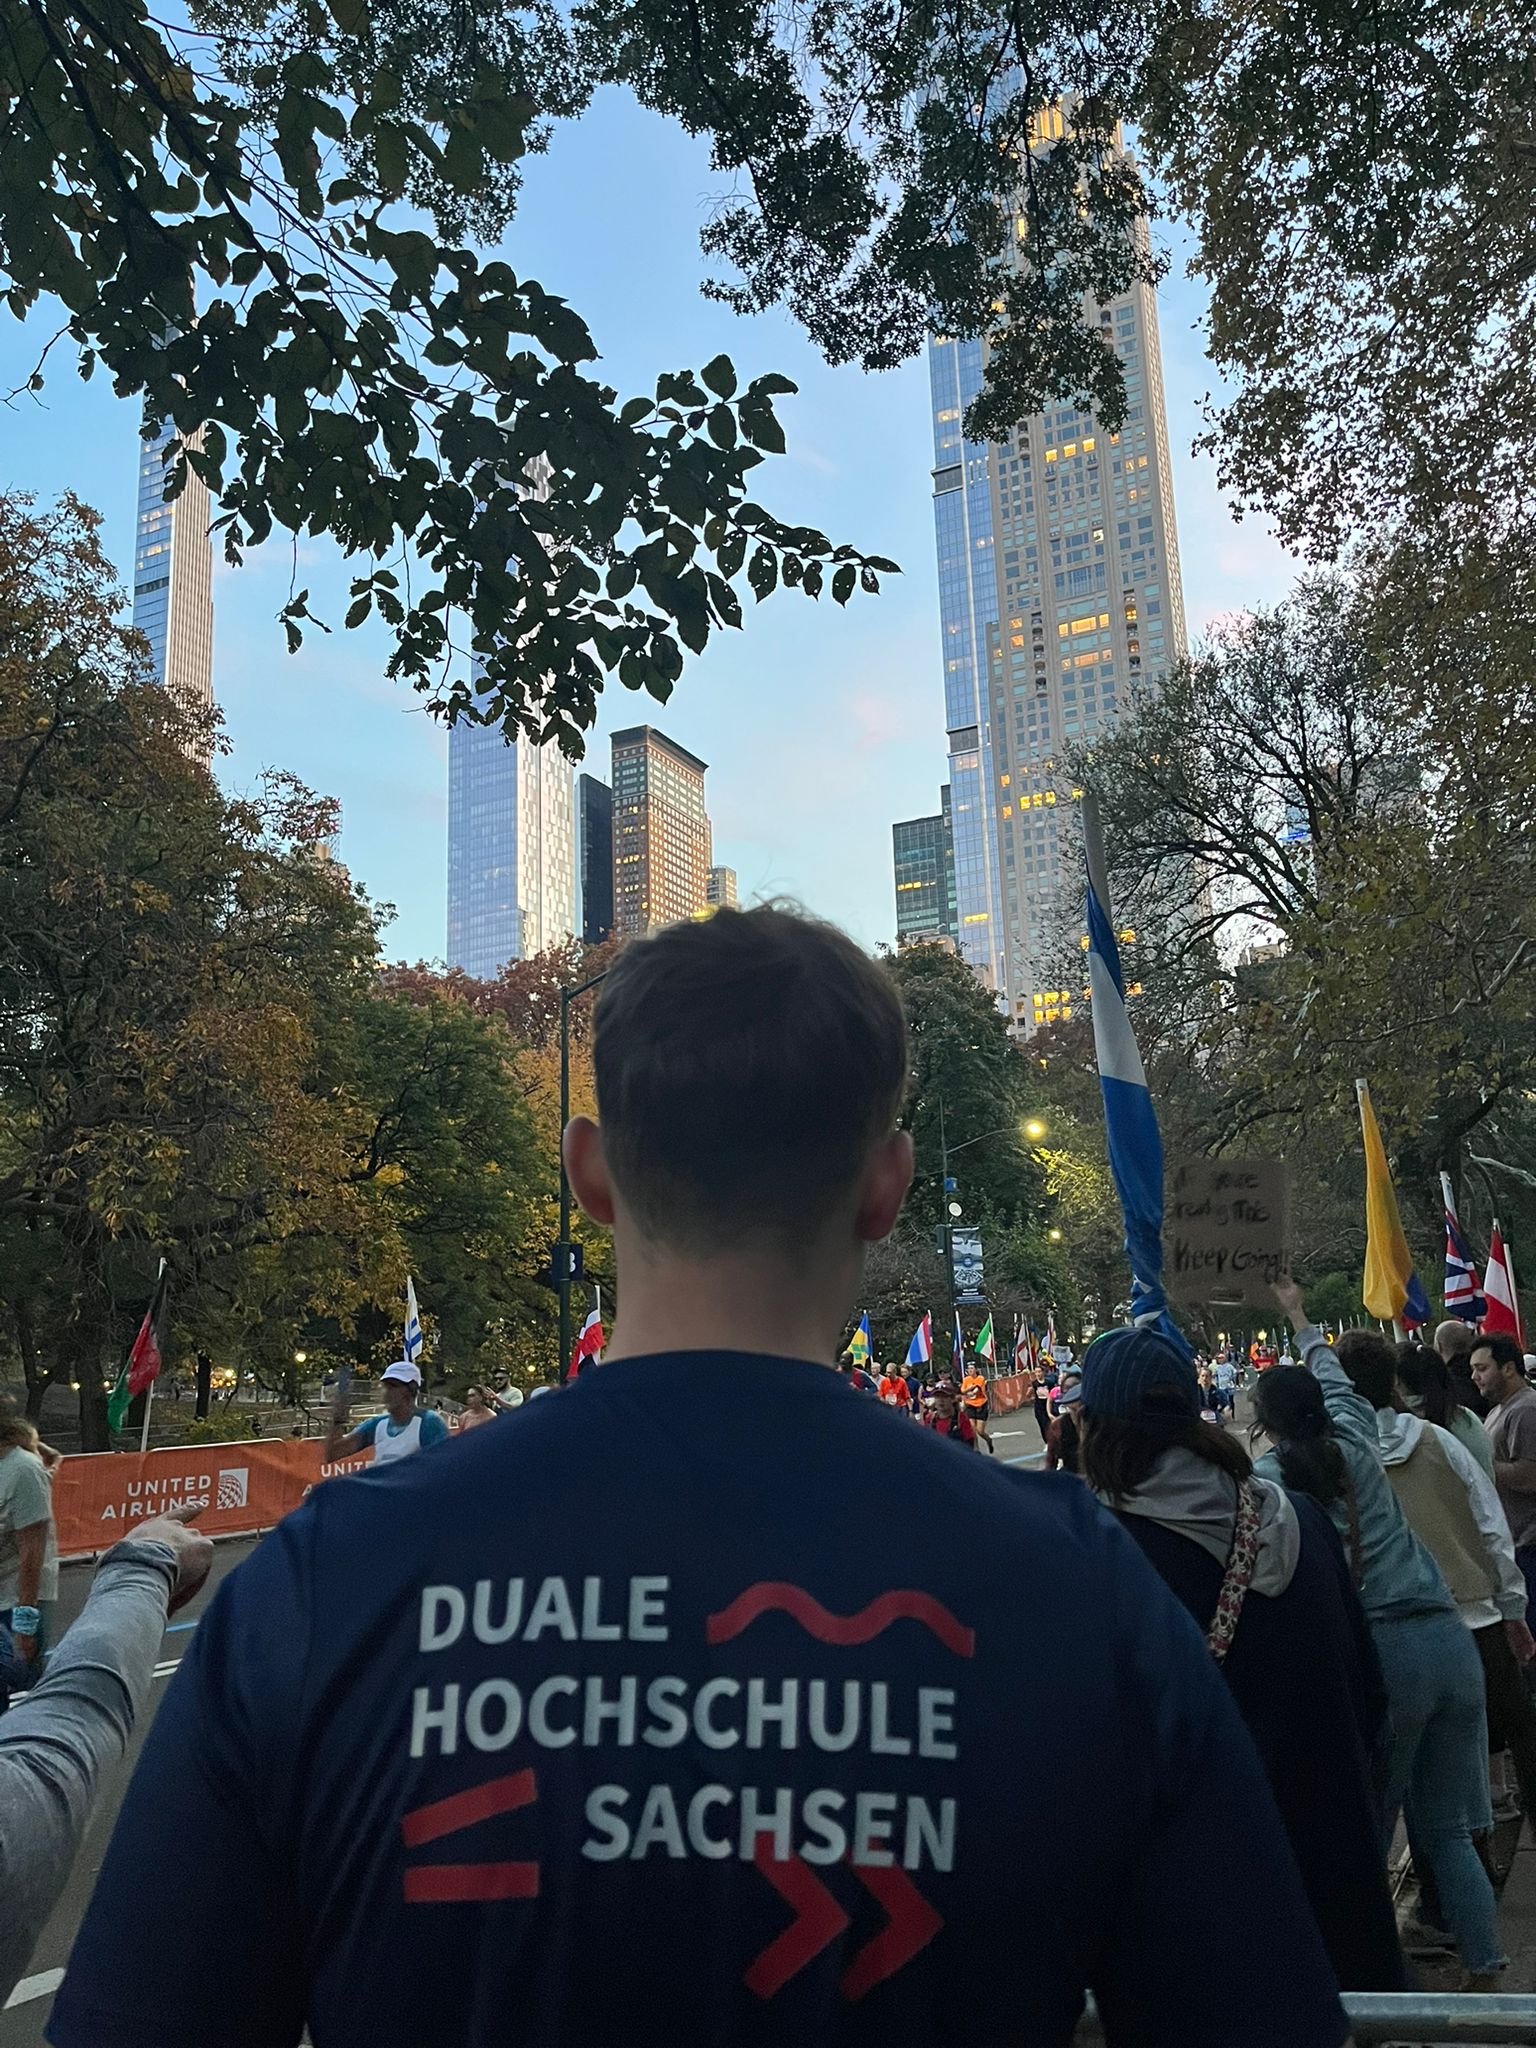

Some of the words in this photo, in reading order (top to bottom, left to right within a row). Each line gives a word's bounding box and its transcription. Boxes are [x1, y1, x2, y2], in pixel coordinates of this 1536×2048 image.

[1175, 1238, 1228, 1273] Keep
[127, 1475, 211, 1497] UNITED
[418, 1575, 670, 1653] DUALE
[409, 1675, 959, 1760] HOCHSCHULE
[581, 1784, 957, 1873] SACHSEN
